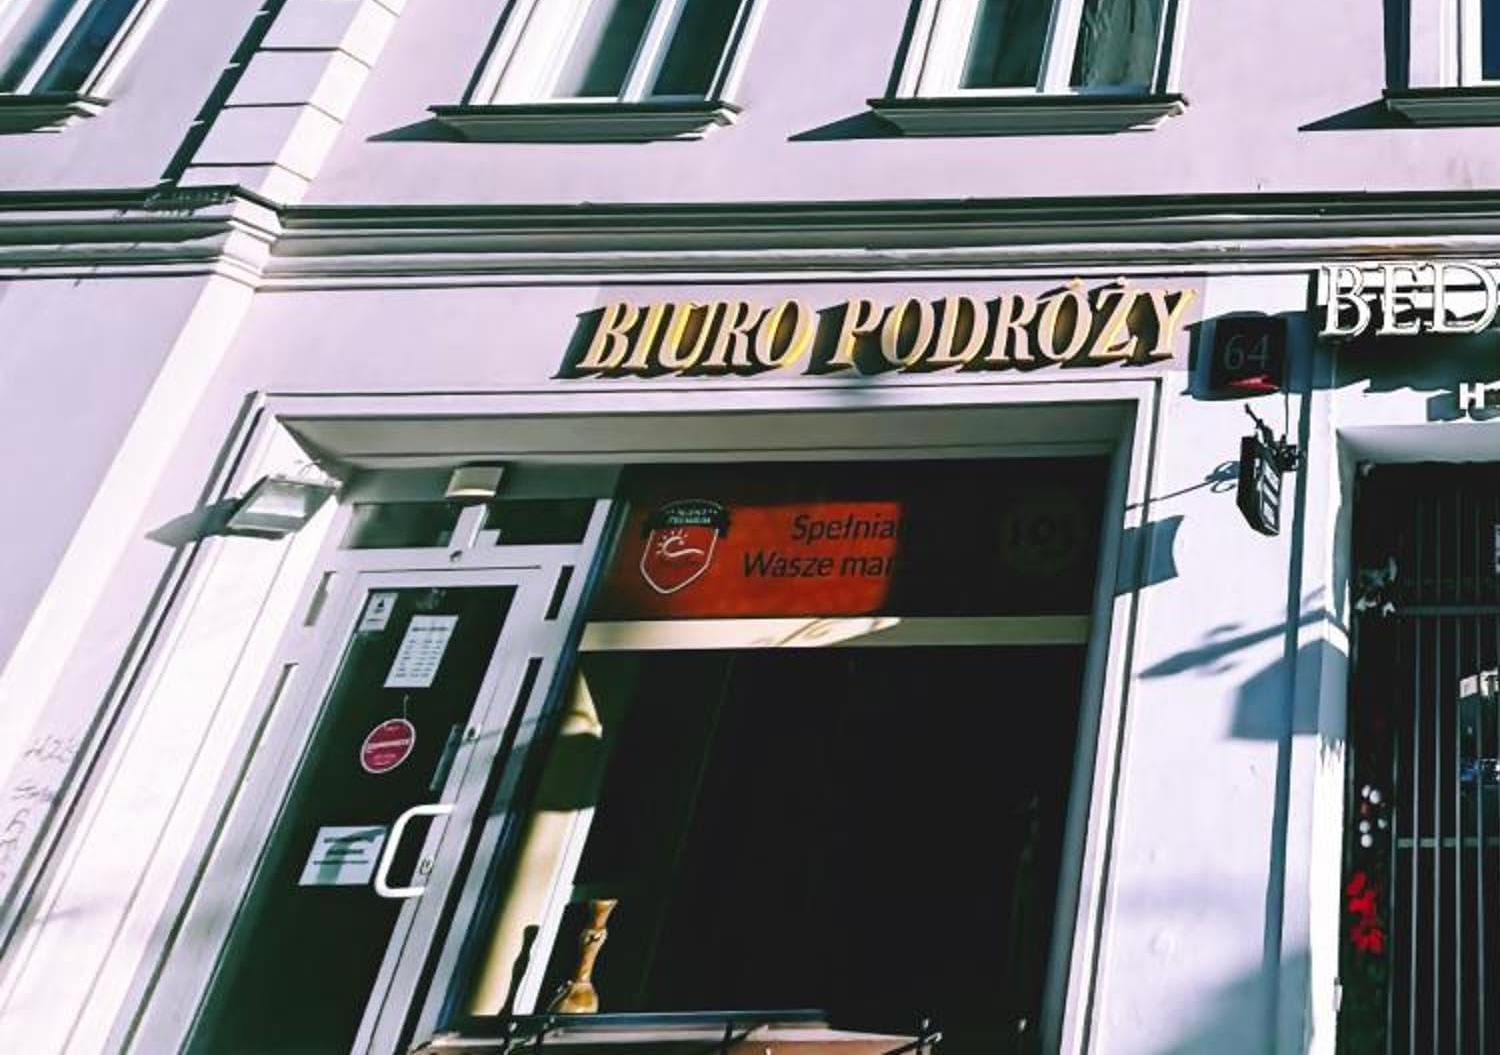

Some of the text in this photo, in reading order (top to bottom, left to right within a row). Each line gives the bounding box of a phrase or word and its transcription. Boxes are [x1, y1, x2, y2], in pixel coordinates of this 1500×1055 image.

[574, 276, 1200, 370] BIURO PODRÓŻY
[1223, 334, 1272, 372] 64
[742, 551, 834, 578] Wasze
